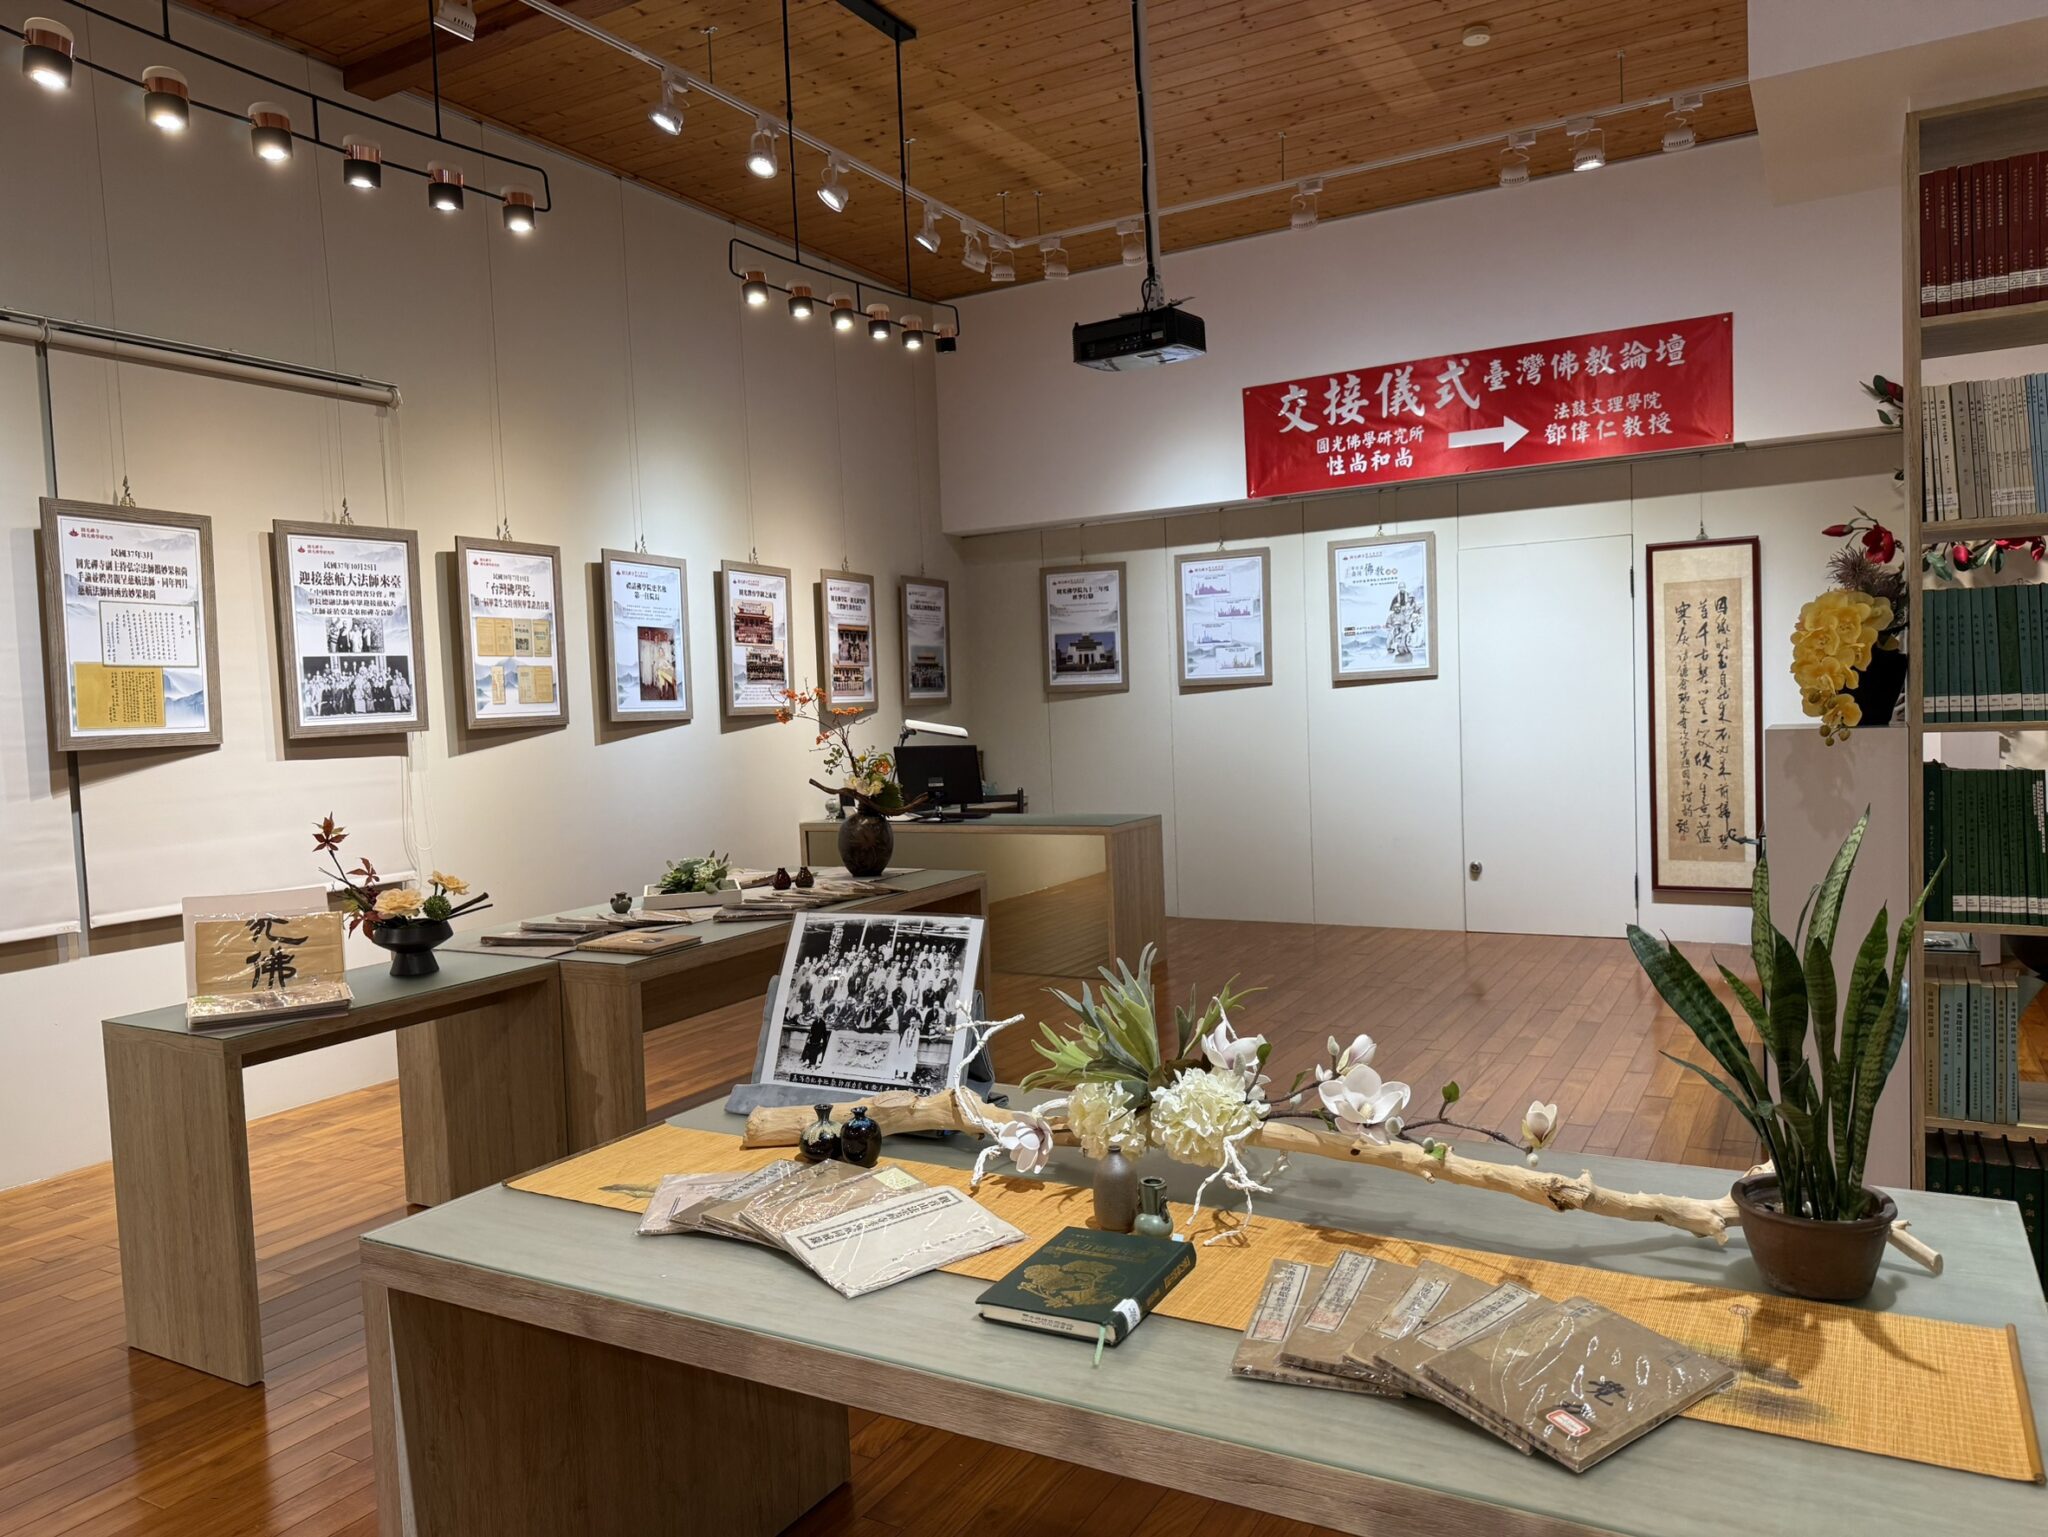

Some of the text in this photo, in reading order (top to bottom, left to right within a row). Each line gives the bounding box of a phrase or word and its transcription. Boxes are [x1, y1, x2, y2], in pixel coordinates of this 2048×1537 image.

[1278, 333, 1688, 434] 交接儀式 臺灣佛教論壇
[1553, 391, 1662, 420] 法鼓文理學院
[1316, 427, 1424, 454] 圓光佛學研究所
[1544, 410, 1673, 446] 鄧偉仁教授
[1326, 446, 1415, 477] 性尚和尚
[299, 570, 402, 589] 迎接慈航大法師來臺
